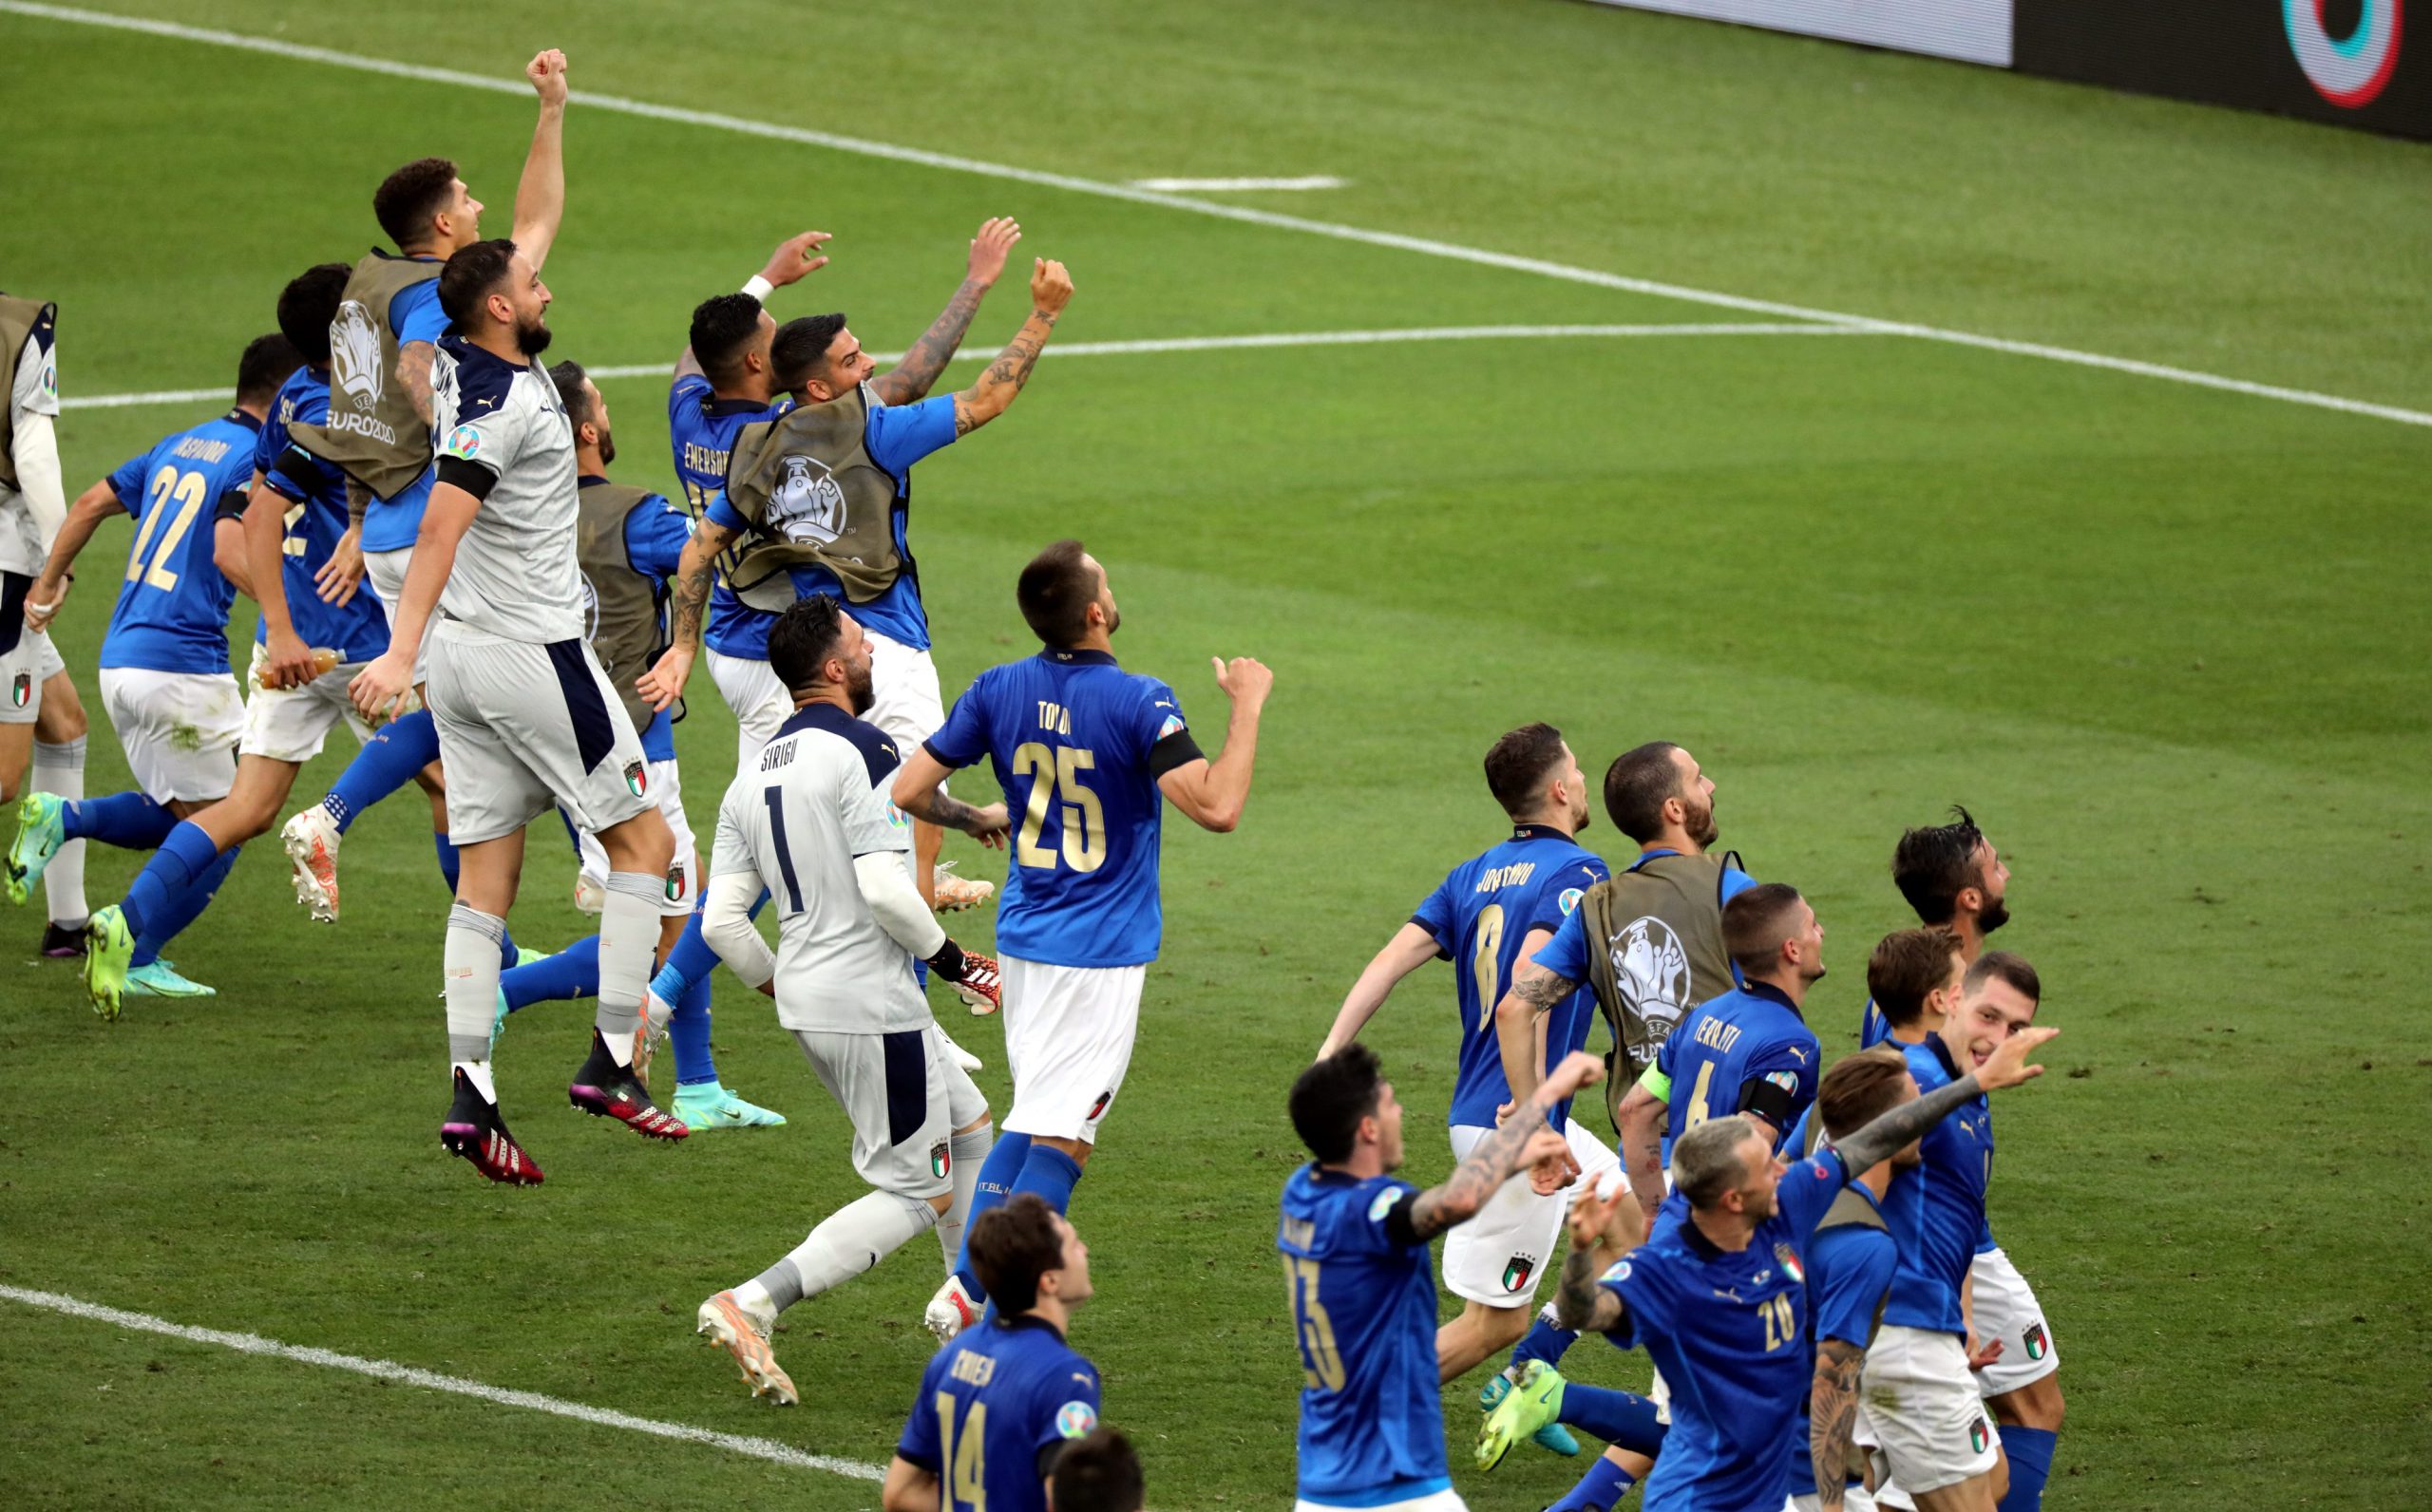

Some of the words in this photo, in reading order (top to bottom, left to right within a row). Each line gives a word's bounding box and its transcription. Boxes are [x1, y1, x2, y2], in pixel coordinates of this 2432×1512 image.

[125, 464, 207, 593] 22
[761, 738, 798, 772] SIRIGU
[1013, 742, 1107, 873] 25
[765, 785, 805, 913] 1
[1473, 903, 1505, 1032] 8
[978, 1181, 1013, 1195] ITALI
[1757, 1291, 1796, 1352] 20
[936, 1390, 986, 1512] 14
